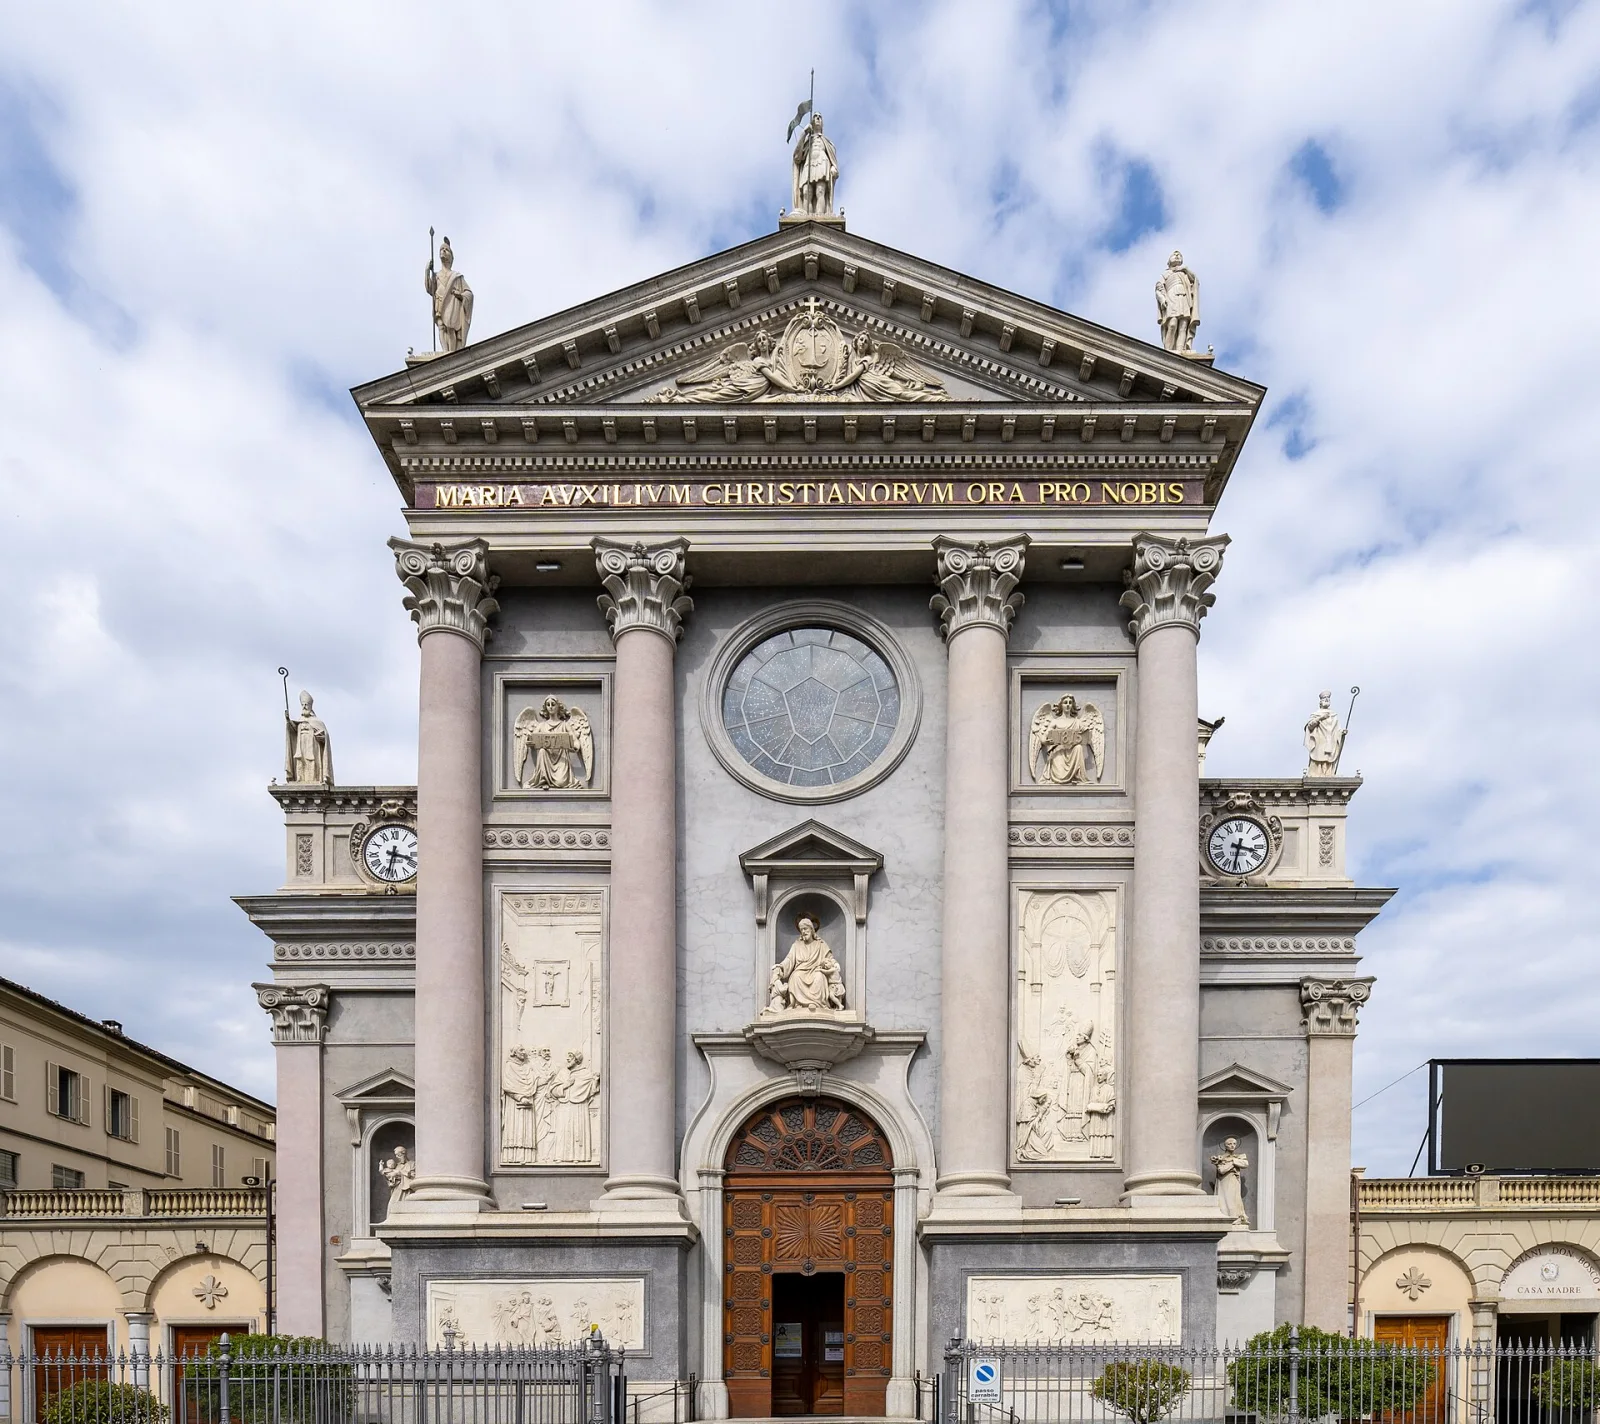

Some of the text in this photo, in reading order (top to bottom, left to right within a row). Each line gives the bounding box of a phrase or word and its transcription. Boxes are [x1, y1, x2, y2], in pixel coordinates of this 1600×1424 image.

[435, 482, 1185, 507] MARIA AVXILIVM CHRISTIANORVM ORA PRO NOBIS
[1500, 1247, 1600, 1284] SALESIANI DON BOSCO
[1547, 1286, 1581, 1294] MADRE
